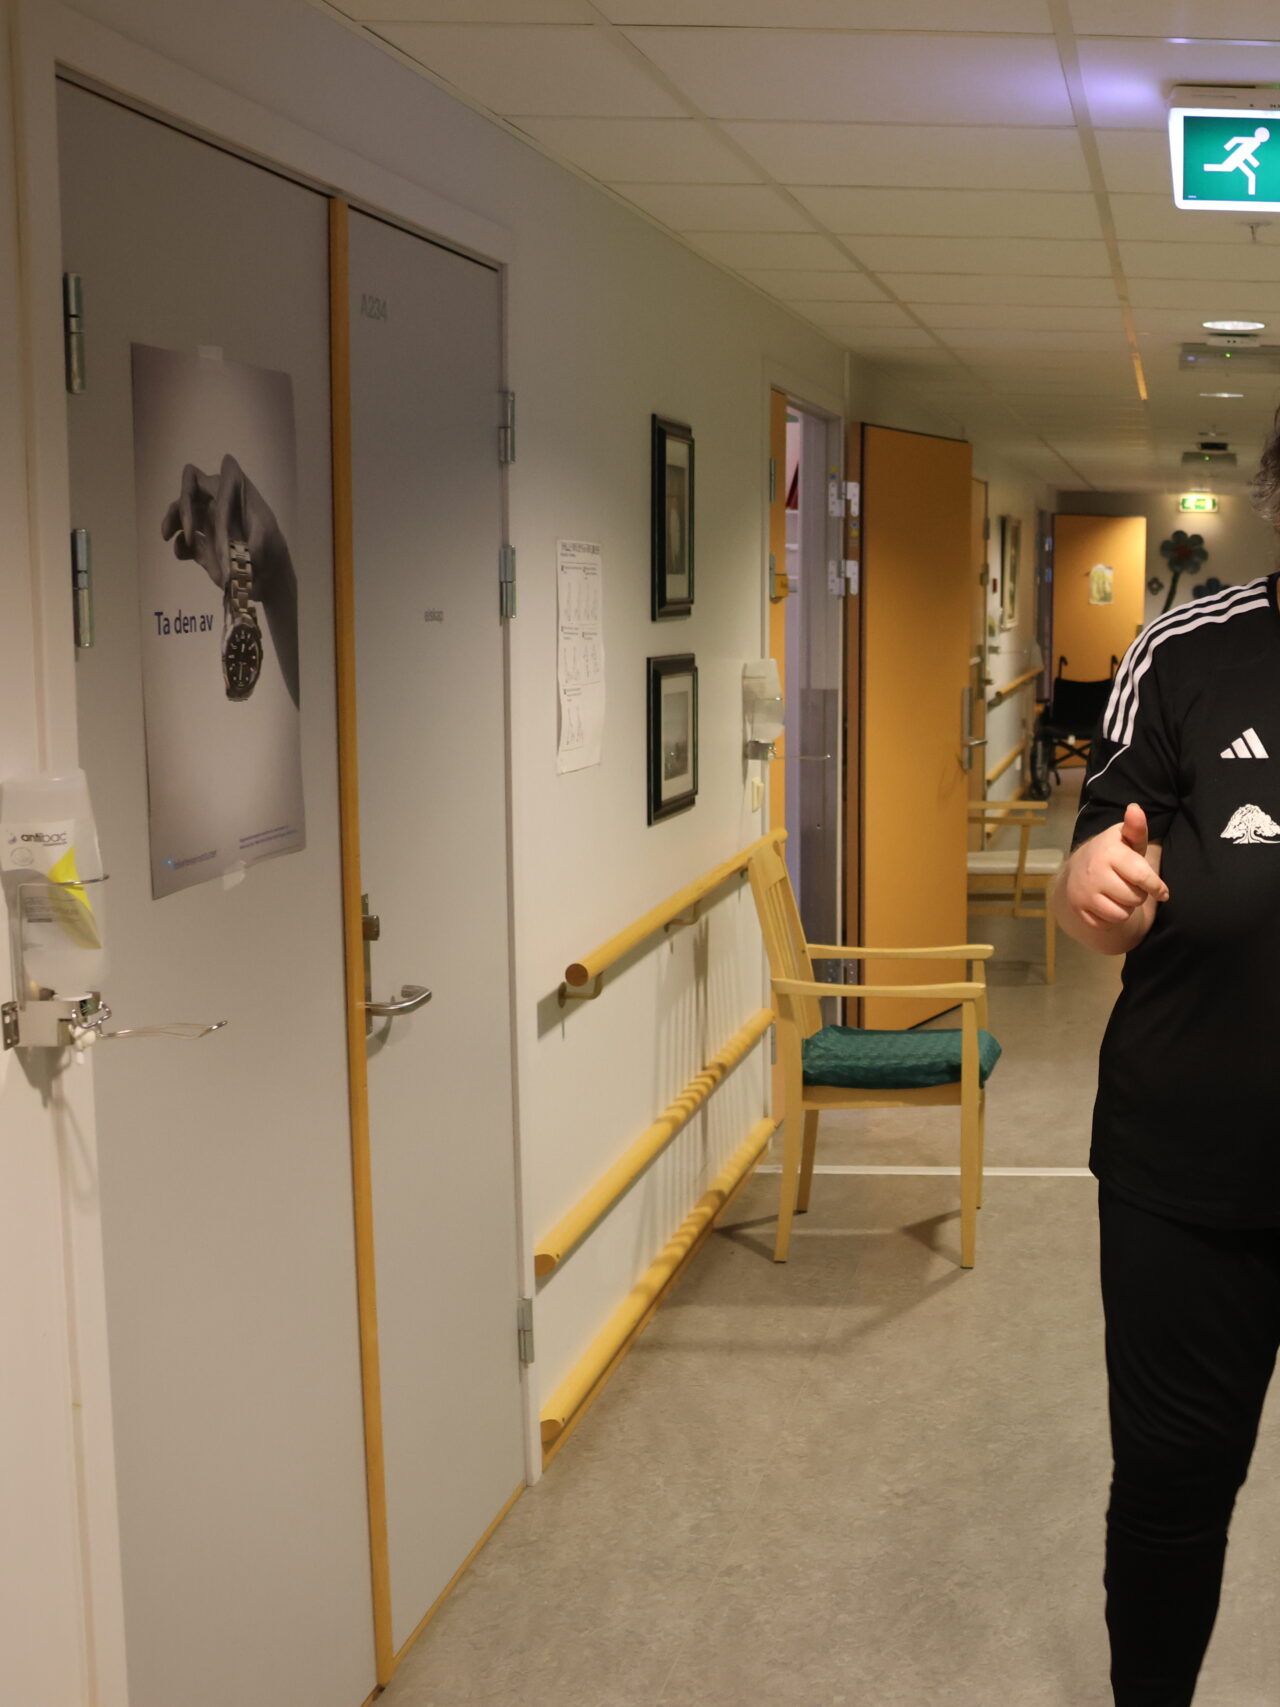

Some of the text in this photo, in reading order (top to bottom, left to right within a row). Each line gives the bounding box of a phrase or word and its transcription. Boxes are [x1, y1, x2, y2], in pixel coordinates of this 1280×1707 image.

[154, 608, 214, 636] Ta den av
